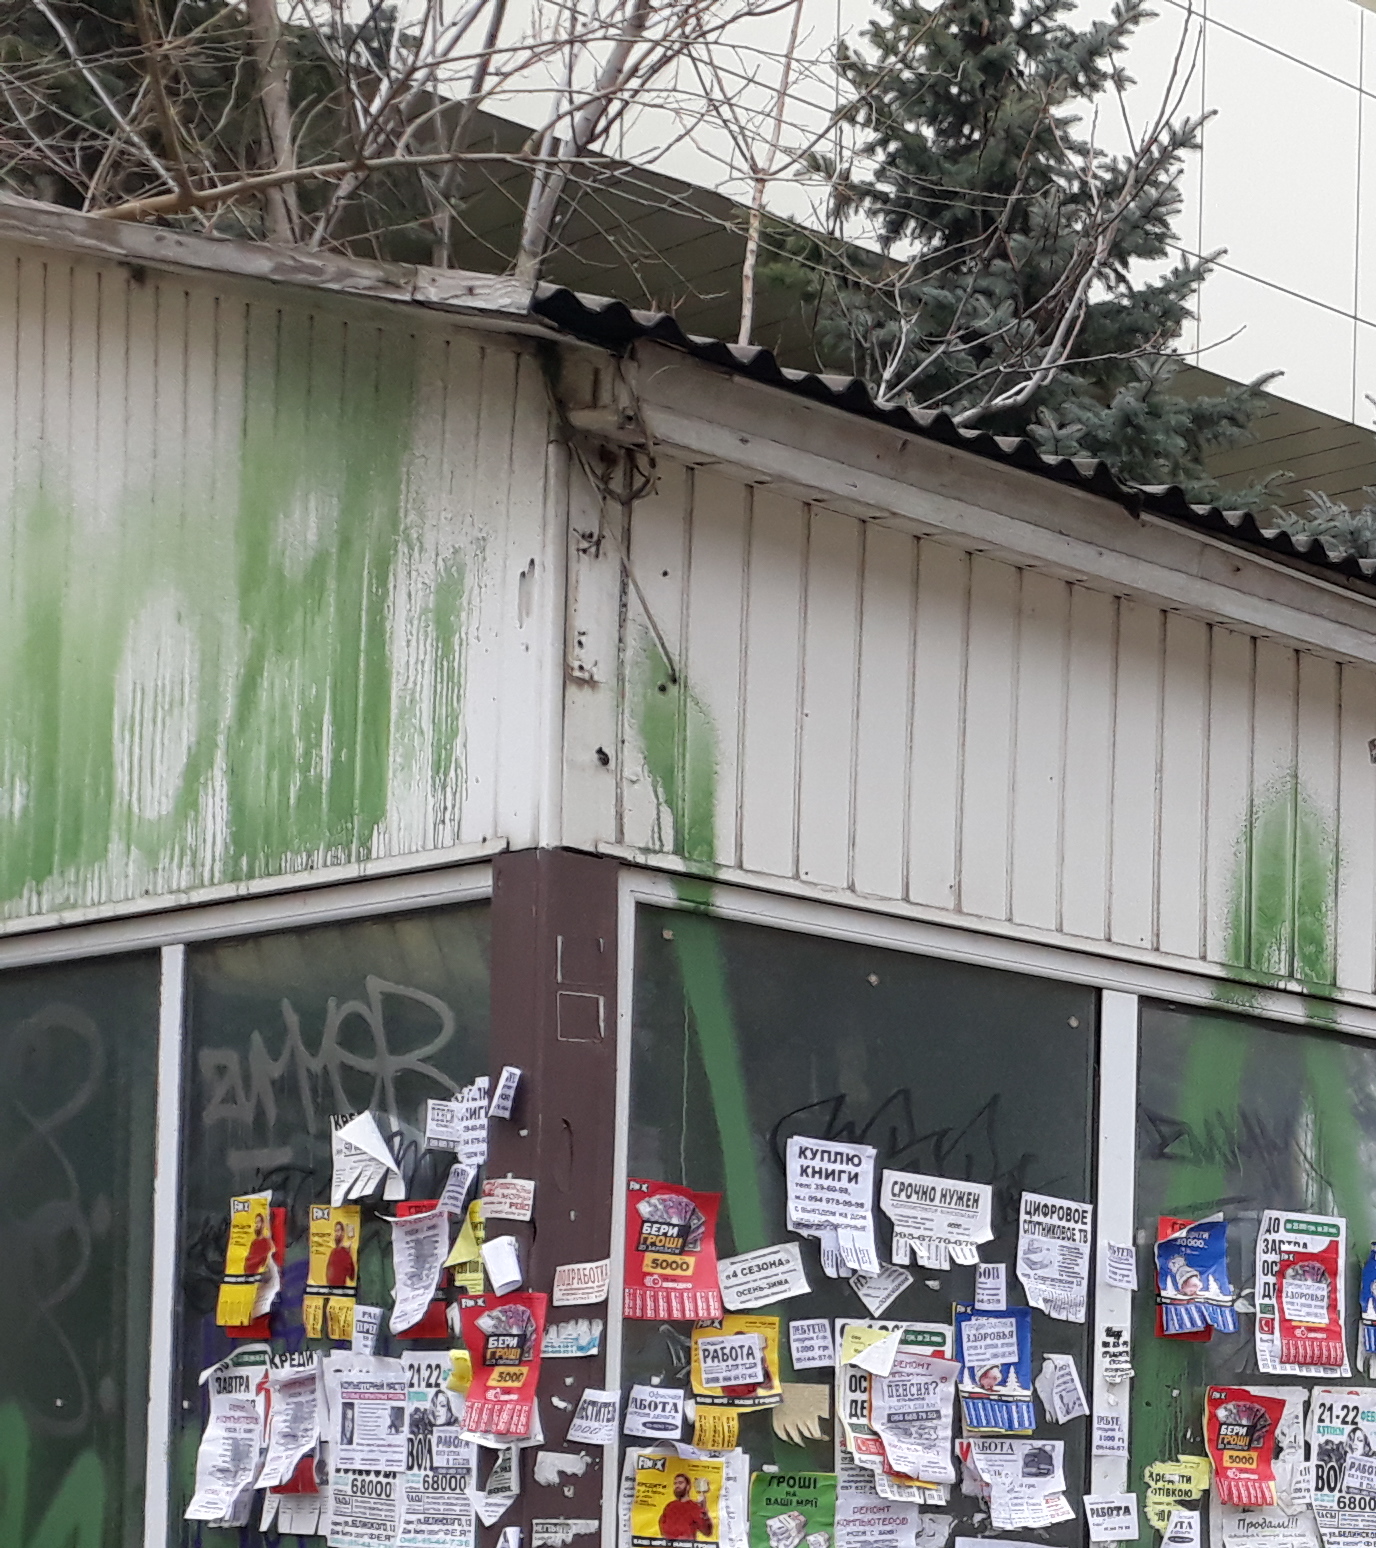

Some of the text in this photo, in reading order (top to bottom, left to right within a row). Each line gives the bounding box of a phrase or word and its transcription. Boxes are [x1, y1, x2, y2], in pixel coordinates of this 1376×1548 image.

[798, 1146, 863, 1168] КУПЛЮ
[799, 1164, 860, 1186] КНИГИ
[890, 1180, 981, 1211] СРОЧНО НУЖЕН
[1023, 1199, 1089, 1226] ЦИФРОВОЕ
[642, 1222, 679, 1237] БЕРИ
[1265, 1217, 1281, 1235] ДО
[640, 1234, 682, 1248] ГРОШІ
[1078, 1229, 1089, 1245] ТВ
[650, 1257, 690, 1273] 5000
[488, 1336, 518, 1348] БЕРИ
[702, 1344, 756, 1364] РАБОТА
[497, 1370, 524, 1383] 5000
[215, 1375, 250, 1395] ЗАВТРА
[887, 1380, 939, 1399] ПЕНСИЯ?
[1317, 1402, 1360, 1426] 21-22
[1220, 1424, 1247, 1436] БЕРИ
[1219, 1434, 1250, 1446] ГРОШІ
[1228, 1453, 1254, 1466] 5000
[351, 1478, 393, 1498] 68000
[422, 1475, 467, 1492] 68000
[768, 1475, 818, 1490] ГРОШІ
[765, 1497, 793, 1507] ВАШІ
[852, 1505, 892, 1515] РЕМОНТ
[1090, 1506, 1131, 1519] РАБОТА
[837, 1516, 909, 1527] КОМПЬЮТЕРОВ
[1237, 1517, 1299, 1532] Продам!!!
